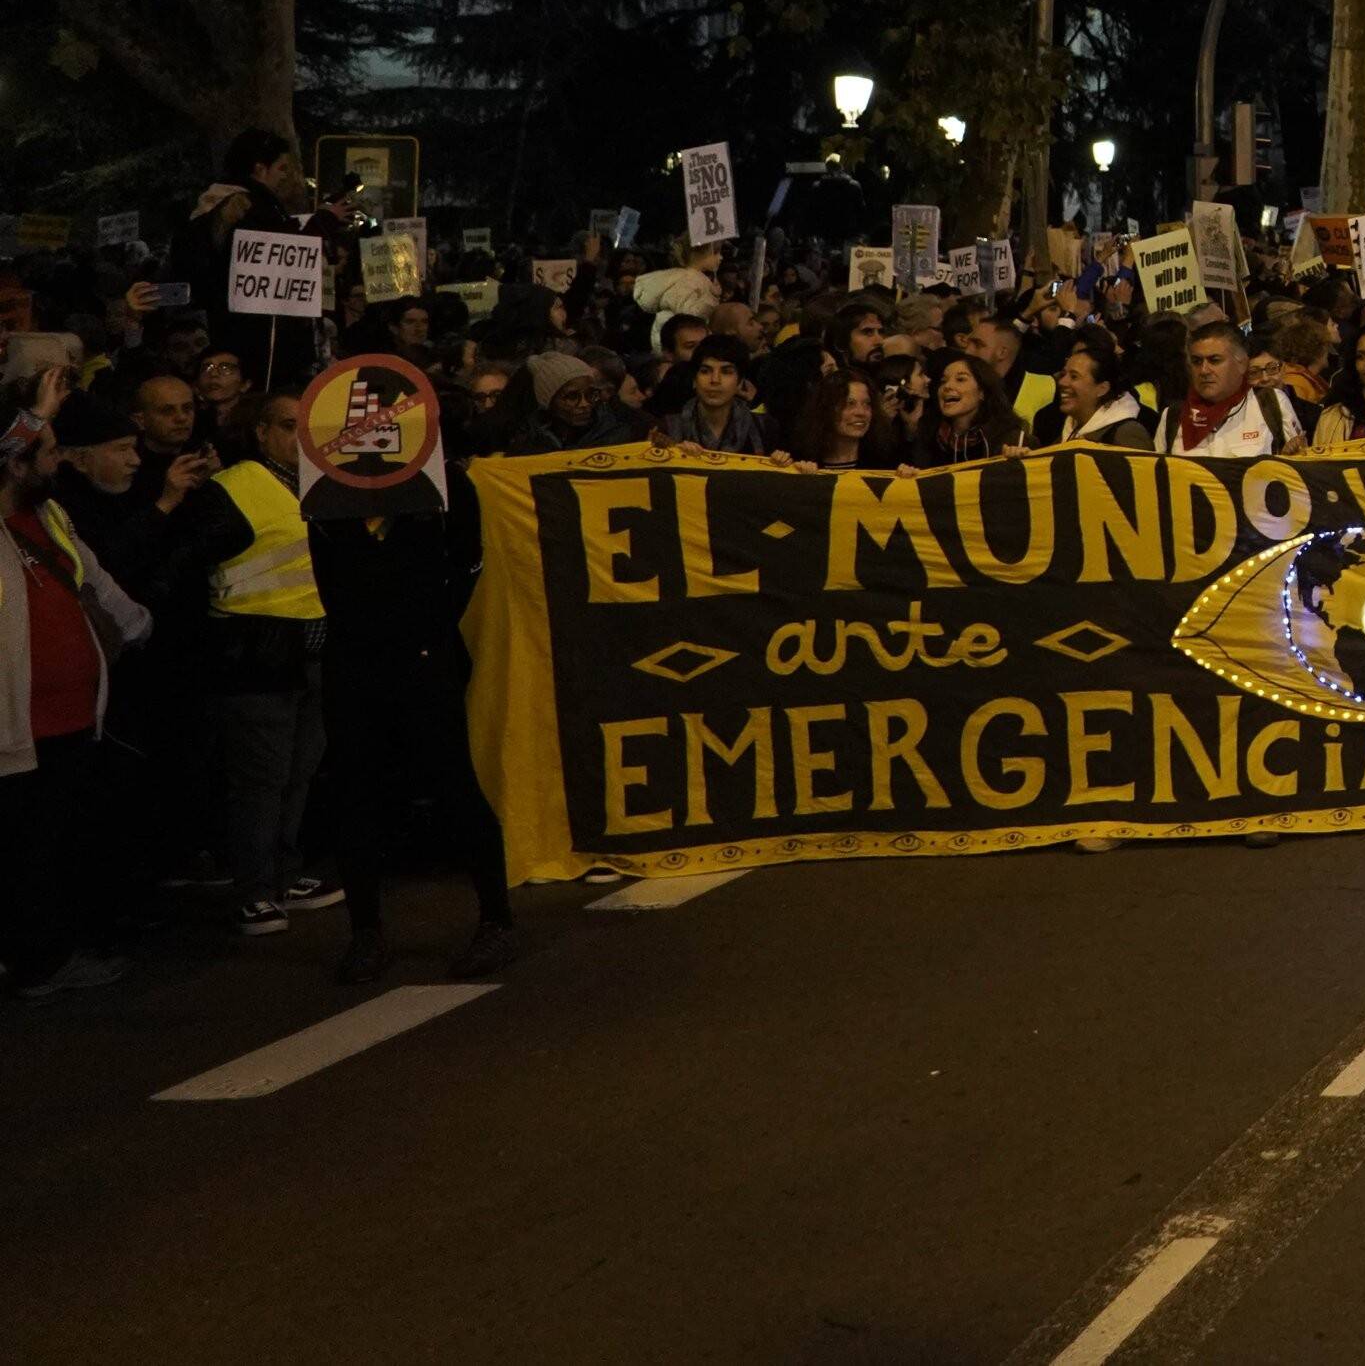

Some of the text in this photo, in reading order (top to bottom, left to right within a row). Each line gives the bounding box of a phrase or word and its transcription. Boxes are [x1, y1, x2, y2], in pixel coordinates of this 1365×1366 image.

[702, 163, 727, 190] NO
[689, 185, 730, 215] planet
[237, 240, 319, 271] WE FIGTH
[955, 252, 972, 268] WE
[1139, 242, 1189, 269] Tomorrow
[235, 275, 316, 303] FOR LIFE!
[1155, 268, 1173, 288] will
[1175, 266, 1187, 282] be
[1156, 295, 1172, 311] too
[569, 472, 760, 604] EL
[823, 452, 1313, 592] MUNDO
[765, 600, 1009, 677] ante
